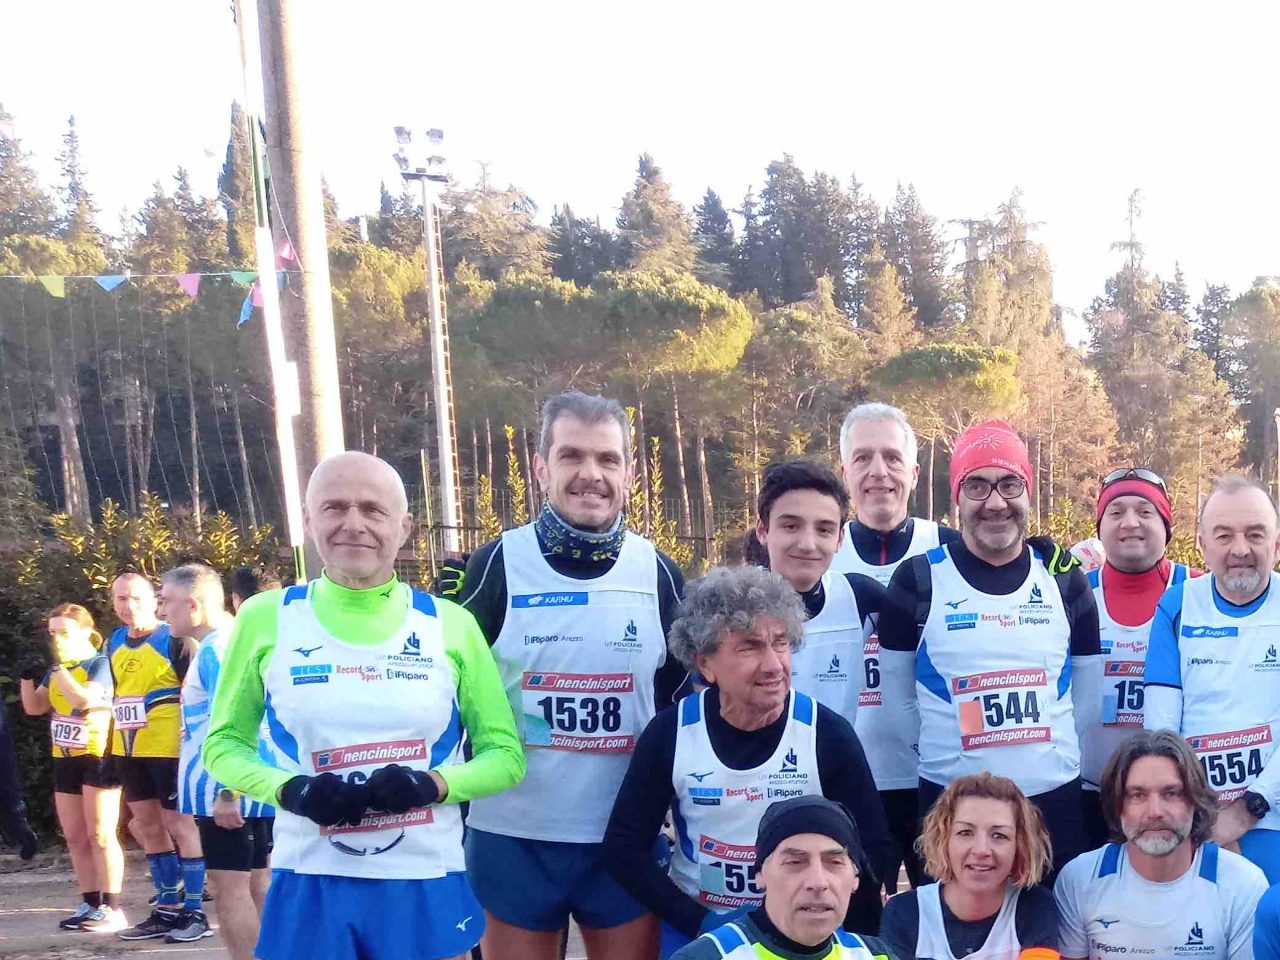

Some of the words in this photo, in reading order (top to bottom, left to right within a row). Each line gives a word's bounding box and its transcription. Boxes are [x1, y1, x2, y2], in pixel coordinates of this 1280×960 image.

[545, 596, 574, 604] KARHU
[387, 655, 433, 663] POLICIANO
[336, 665, 362, 674] Record
[361, 673, 382, 682] Sport
[555, 676, 630, 691] nencinisport
[980, 672, 1044, 688] nencinisport
[1114, 680, 1145, 711] 15
[113, 705, 139, 722] 1801
[537, 696, 621, 734] 1538
[972, 690, 1041, 727] 544
[54, 723, 82, 741] 1792
[968, 730, 1047, 746] nencinisport.com
[1207, 729, 1268, 748] nencinisport
[343, 742, 424, 764] nencinisport
